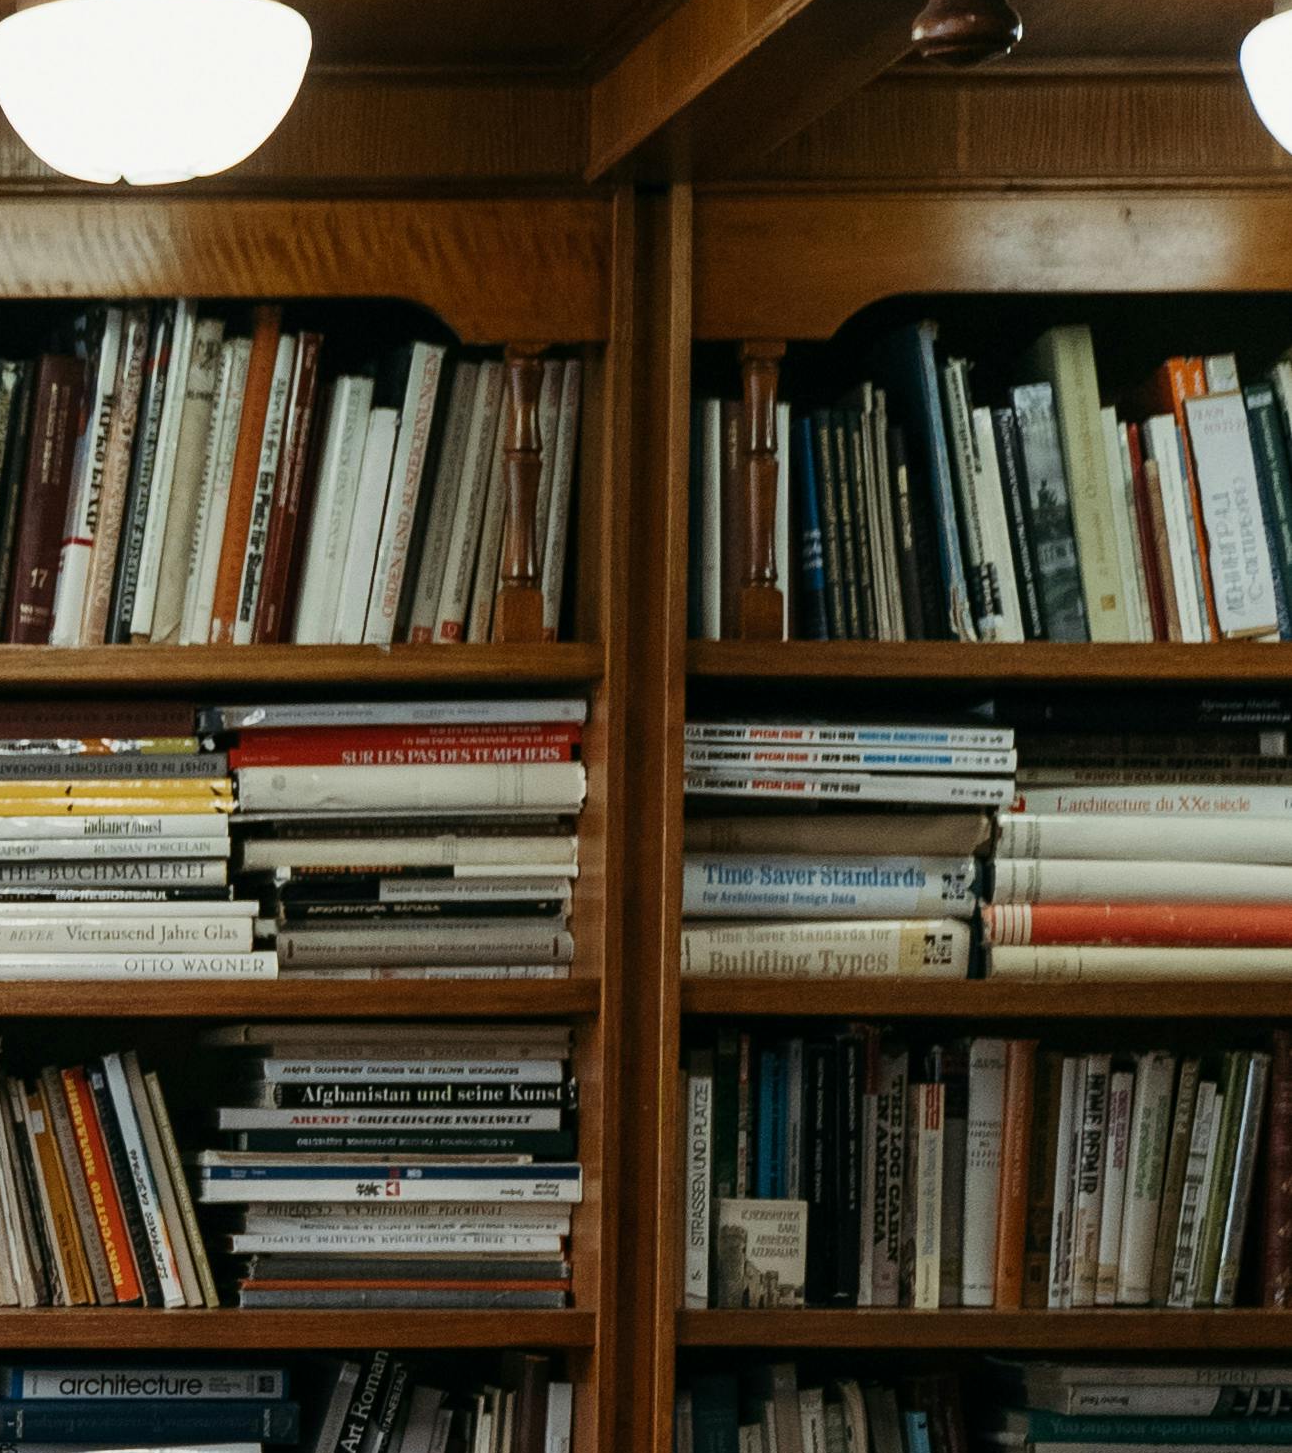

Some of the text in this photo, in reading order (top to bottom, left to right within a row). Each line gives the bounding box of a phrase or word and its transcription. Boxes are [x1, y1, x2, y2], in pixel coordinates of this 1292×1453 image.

[342, 747, 559, 764] SUR LES PAS DES TEMPLIERS
[819, 866, 926, 888] Standards
[66, 924, 154, 942] Viertausend
[160, 925, 199, 945] Jahre
[204, 924, 239, 941] Glas
[124, 956, 265, 974] OTTO WAGNER
[707, 950, 887, 974] Building Types
[302, 1085, 561, 1107] Afghanistan und seine Kunst
[691, 1139, 707, 1244] STRASSEN UND
[873, 1124, 887, 1244] AMERICA
[88, 1179, 124, 1286] ИСКУССТВО
[58, 1372, 202, 1398] architecture
[349, 1347, 391, 1420] Roman
[337, 1421, 365, 1453] Art
